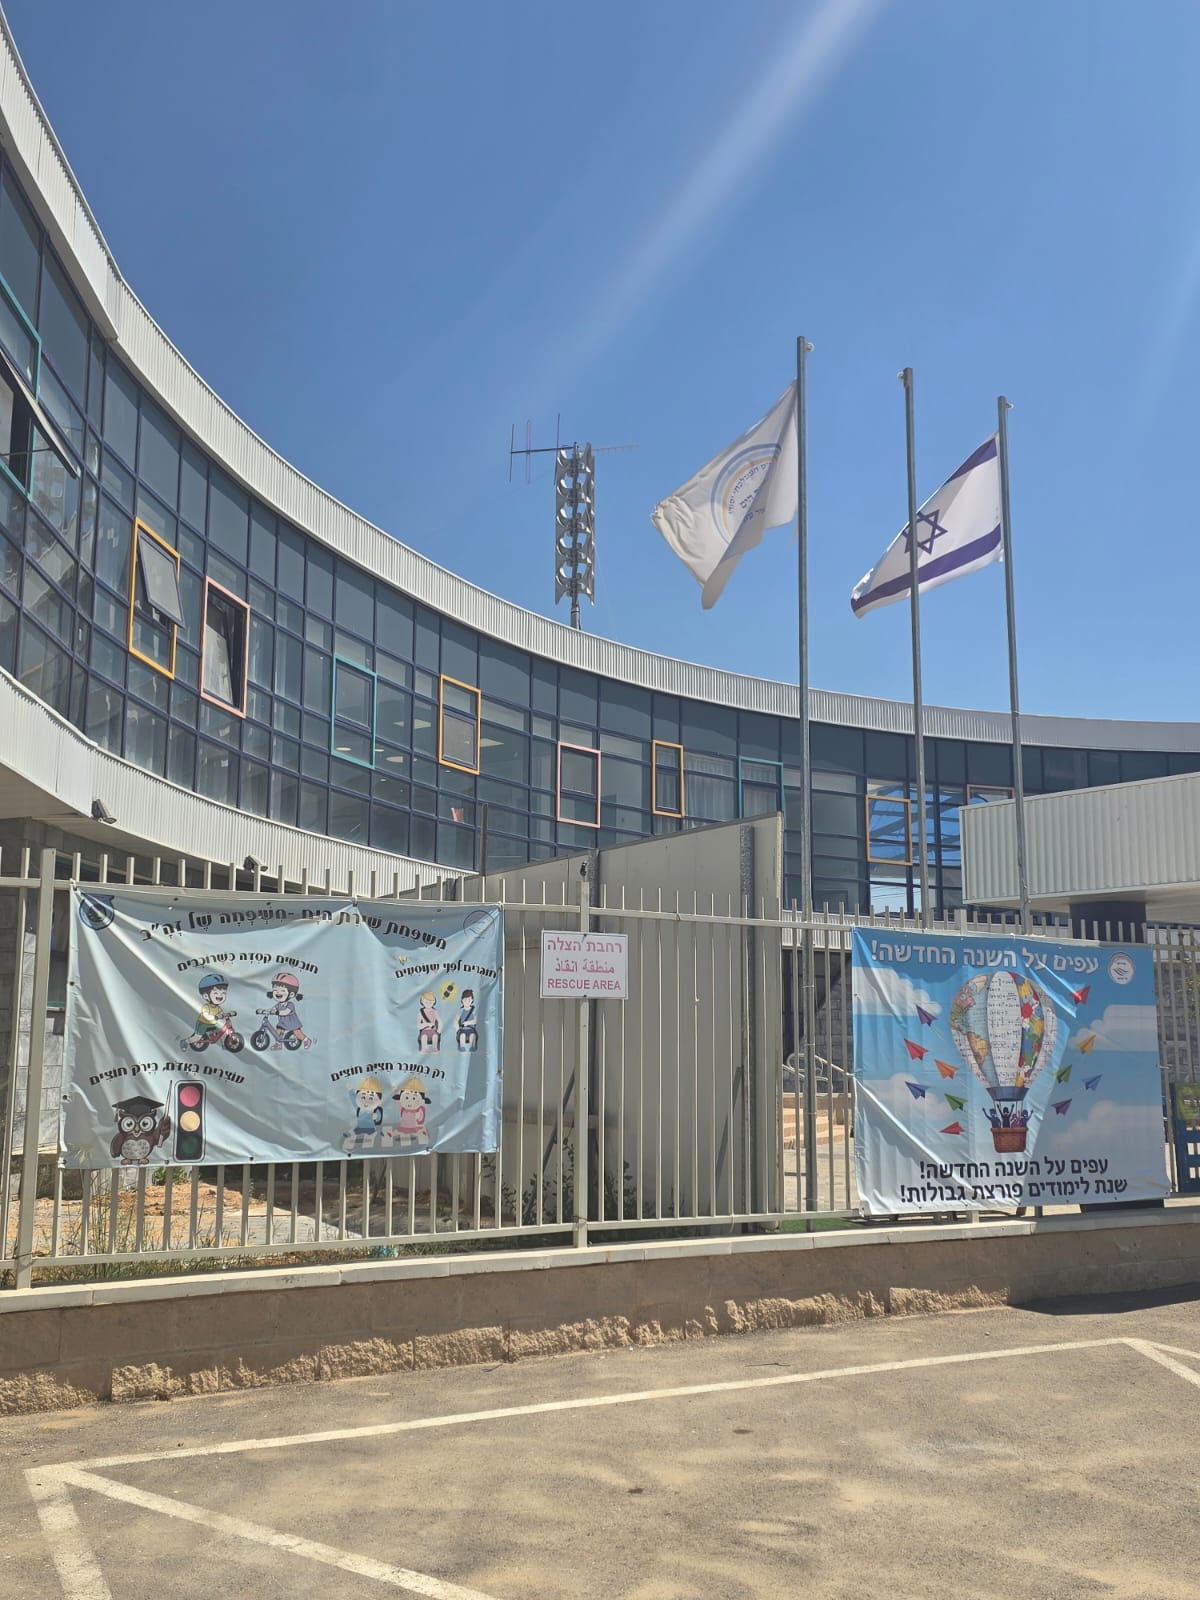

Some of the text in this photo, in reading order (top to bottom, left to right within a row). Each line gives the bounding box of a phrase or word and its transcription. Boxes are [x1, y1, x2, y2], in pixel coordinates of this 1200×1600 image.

[547, 937, 622, 953] רחבת הצלה
[871, 939, 1098, 974] עפים על השנה החדשה!
[547, 978, 621, 990] RESCUE AREA
[432, 1068, 446, 1079] רק
[920, 1155, 1108, 1179] עפים על השנה החדשה!
[900, 1176, 1128, 1203] שנת לימודים פורצת גבולות!
